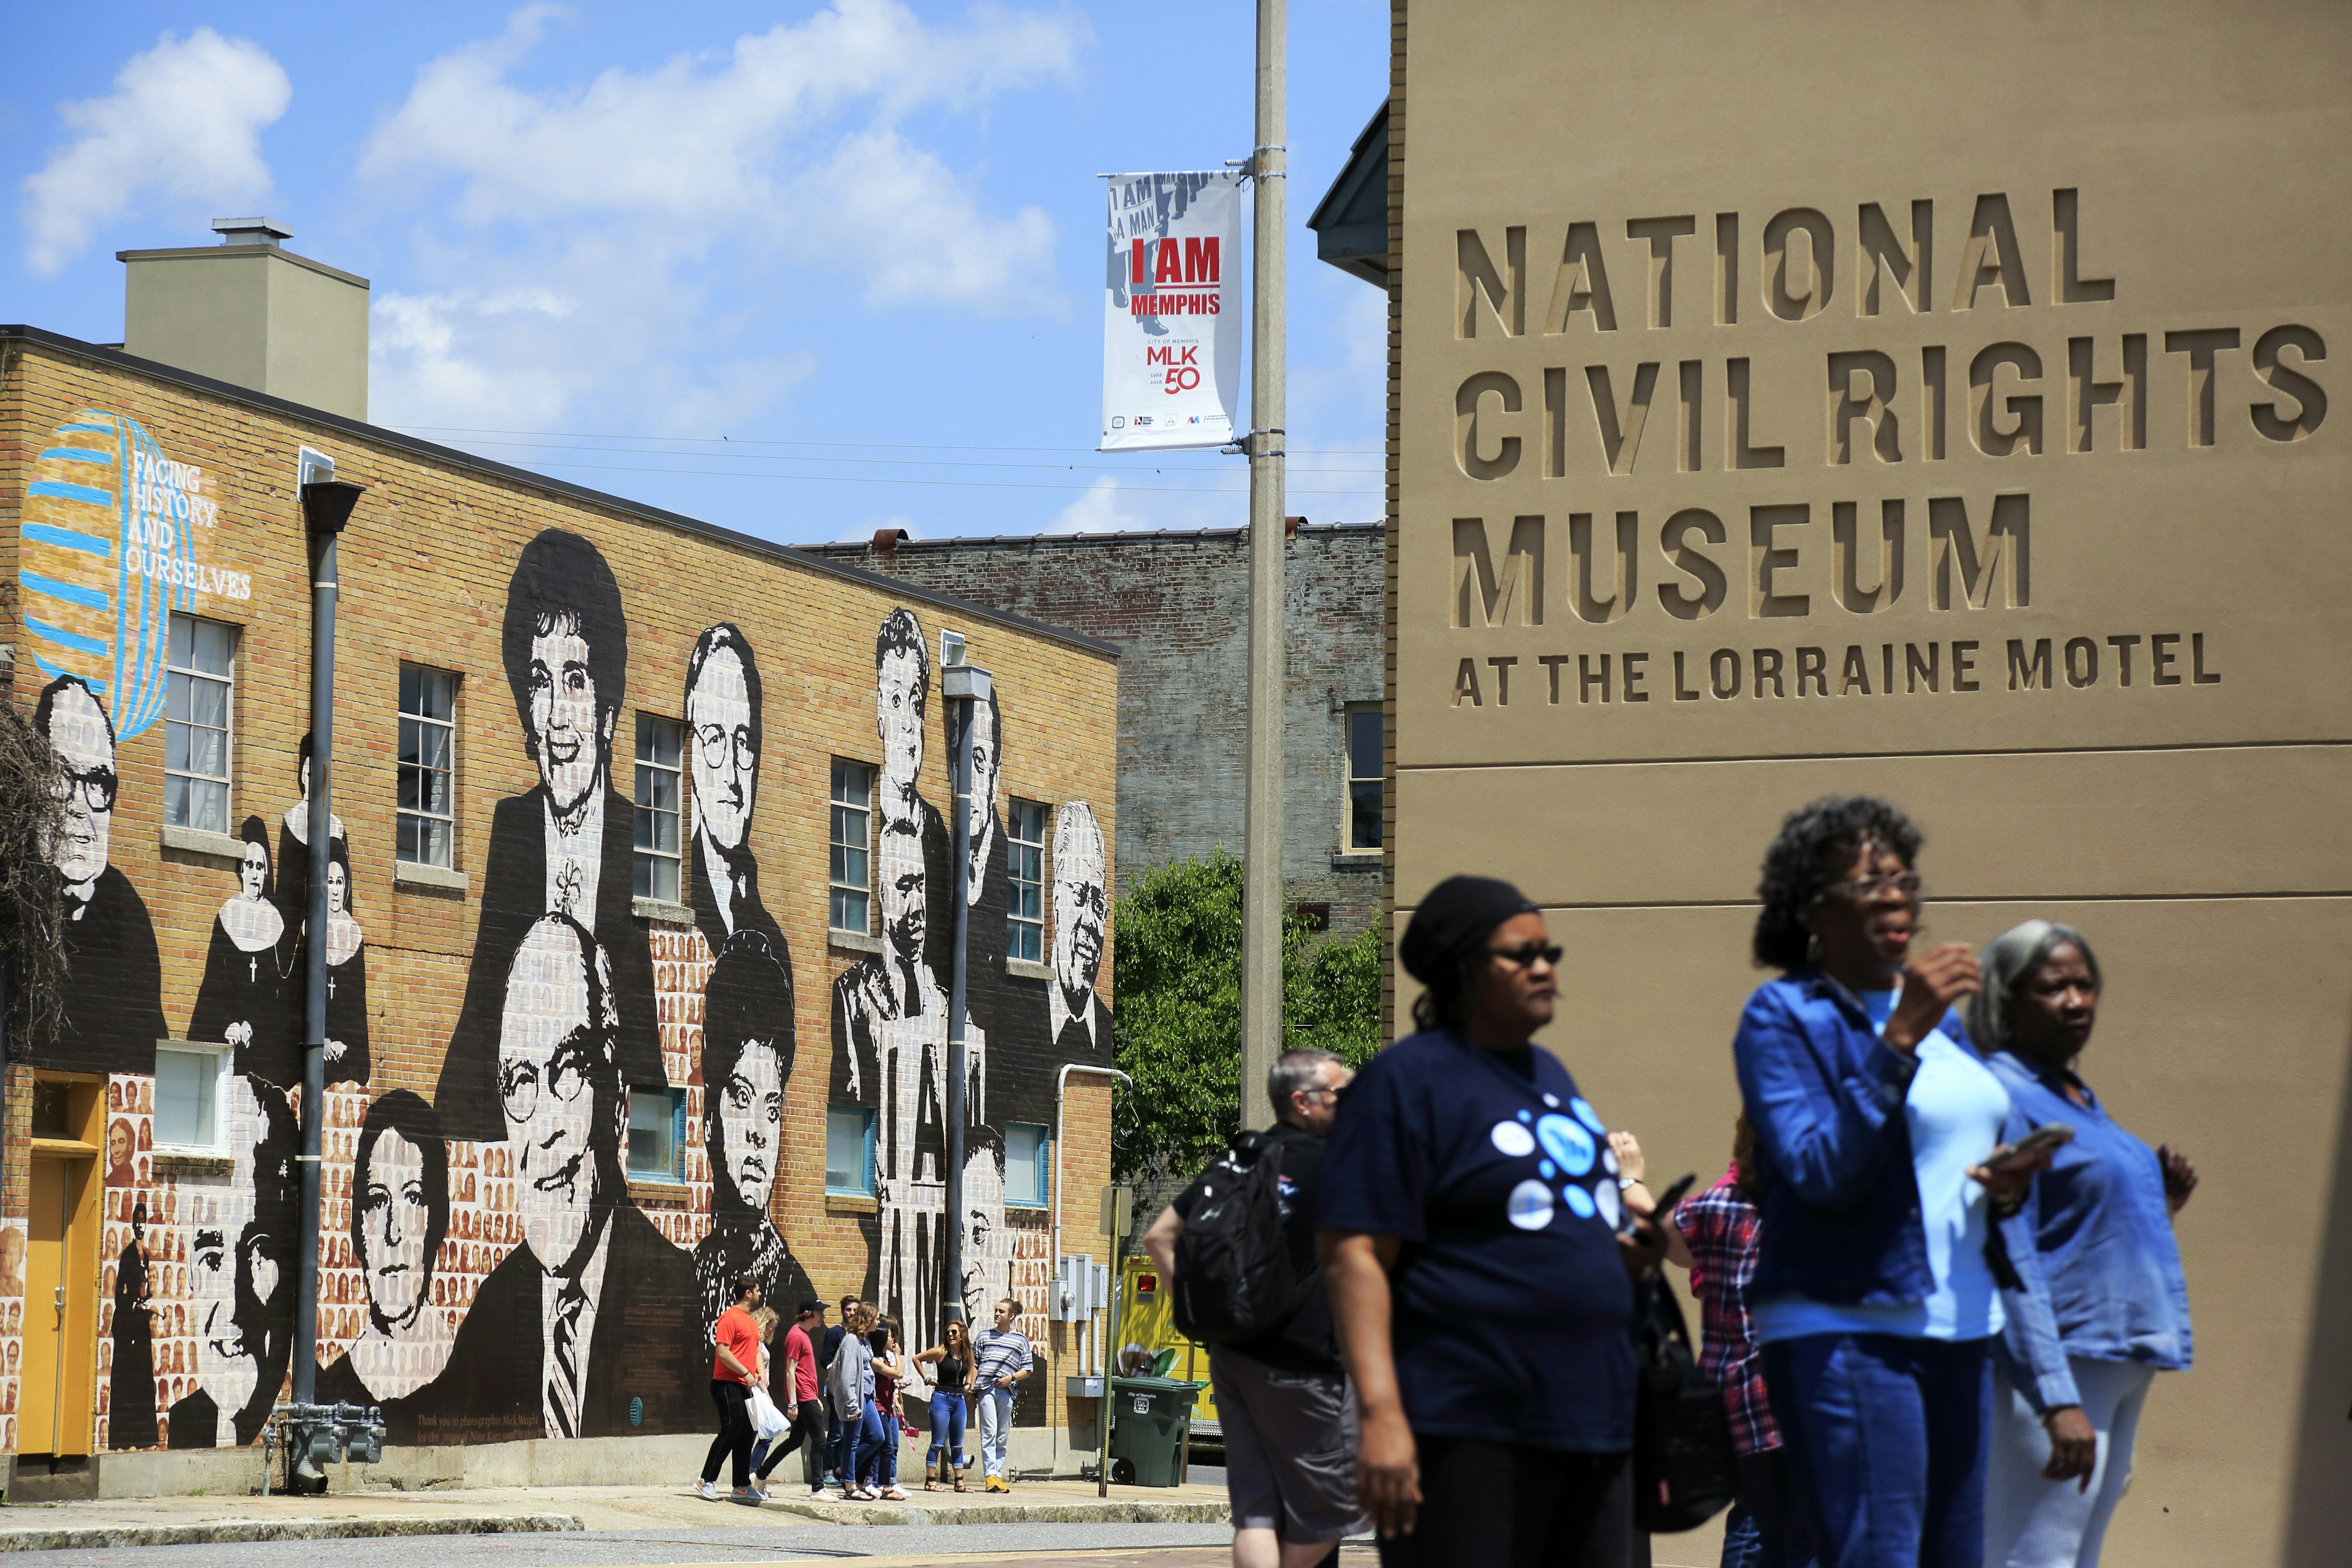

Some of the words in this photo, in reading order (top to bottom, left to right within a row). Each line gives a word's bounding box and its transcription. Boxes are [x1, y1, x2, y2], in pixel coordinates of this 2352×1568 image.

[1112, 187, 1118, 211] I
[1123, 175, 1152, 208] AM
[1117, 217, 1125, 239] A
[1129, 205, 1155, 237] MAN
[1131, 238, 1144, 284] I
[1155, 236, 1219, 283] AM
[1457, 187, 2116, 341] NATIONAL
[1131, 293, 1221, 316] MEMPHIS
[1147, 345, 1199, 366] MLK
[1164, 366, 1200, 394] 50
[1453, 355, 1786, 481] CIVIL
[1826, 322, 2328, 466] RIGHTS
[133, 450, 200, 492] FACING
[131, 482, 219, 527] HISTORY
[127, 514, 174, 549] AND
[126, 546, 252, 600] OURSELVES
[1450, 492, 2031, 628] MUSEUM
[1451, 655, 1518, 707] AT
[1538, 651, 1649, 704] THE
[1672, 640, 1980, 704] LORRAINE
[2006, 631, 2222, 691] MOTEL
[418, 1414, 437, 1426] Thank
[439, 1418, 450, 1428] you
[452, 1417, 459, 1426] to
[460, 1415, 501, 1428] photographer
[503, 1414, 517, 1426] Mick
[518, 1414, 538, 1427] Wright
[418, 1431, 427, 1442] for
[429, 1431, 439, 1442] the
[470, 1431, 484, 1441] Nina
